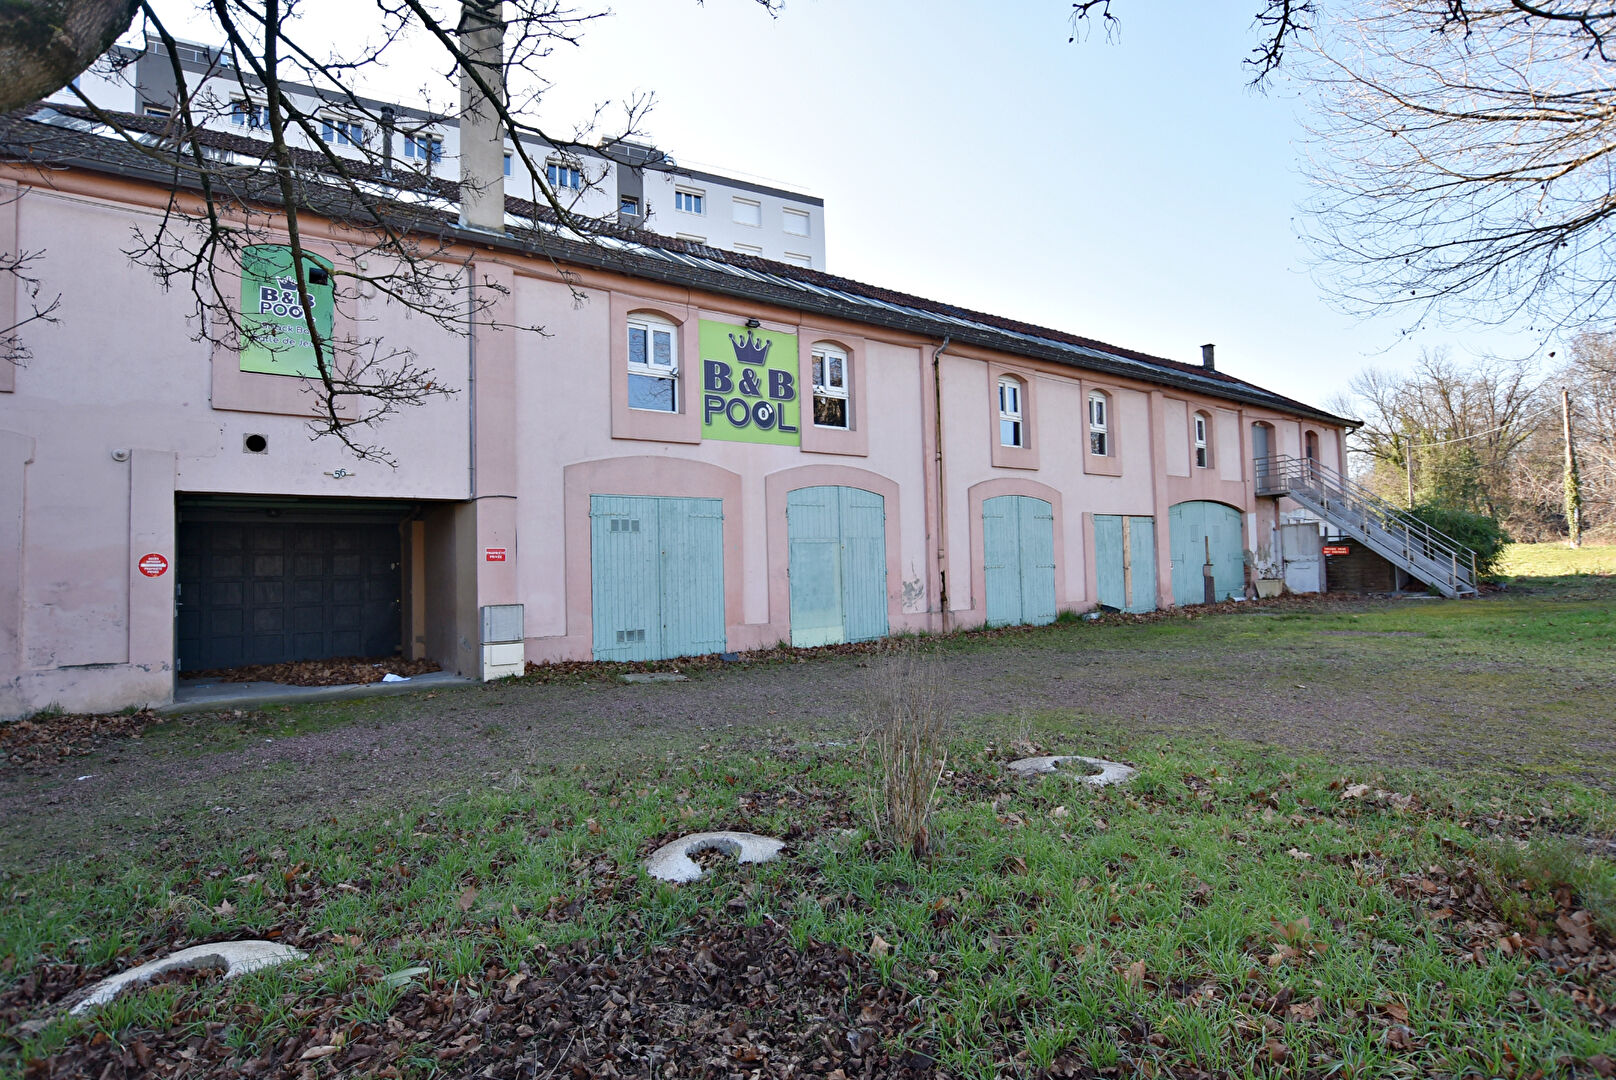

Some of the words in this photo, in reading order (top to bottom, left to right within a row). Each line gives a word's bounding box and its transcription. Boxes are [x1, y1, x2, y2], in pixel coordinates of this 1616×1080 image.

[260, 301, 316, 322] POO
[296, 326, 311, 336] Ba
[704, 394, 799, 433] POOL
[333, 468, 346, 480] 56
